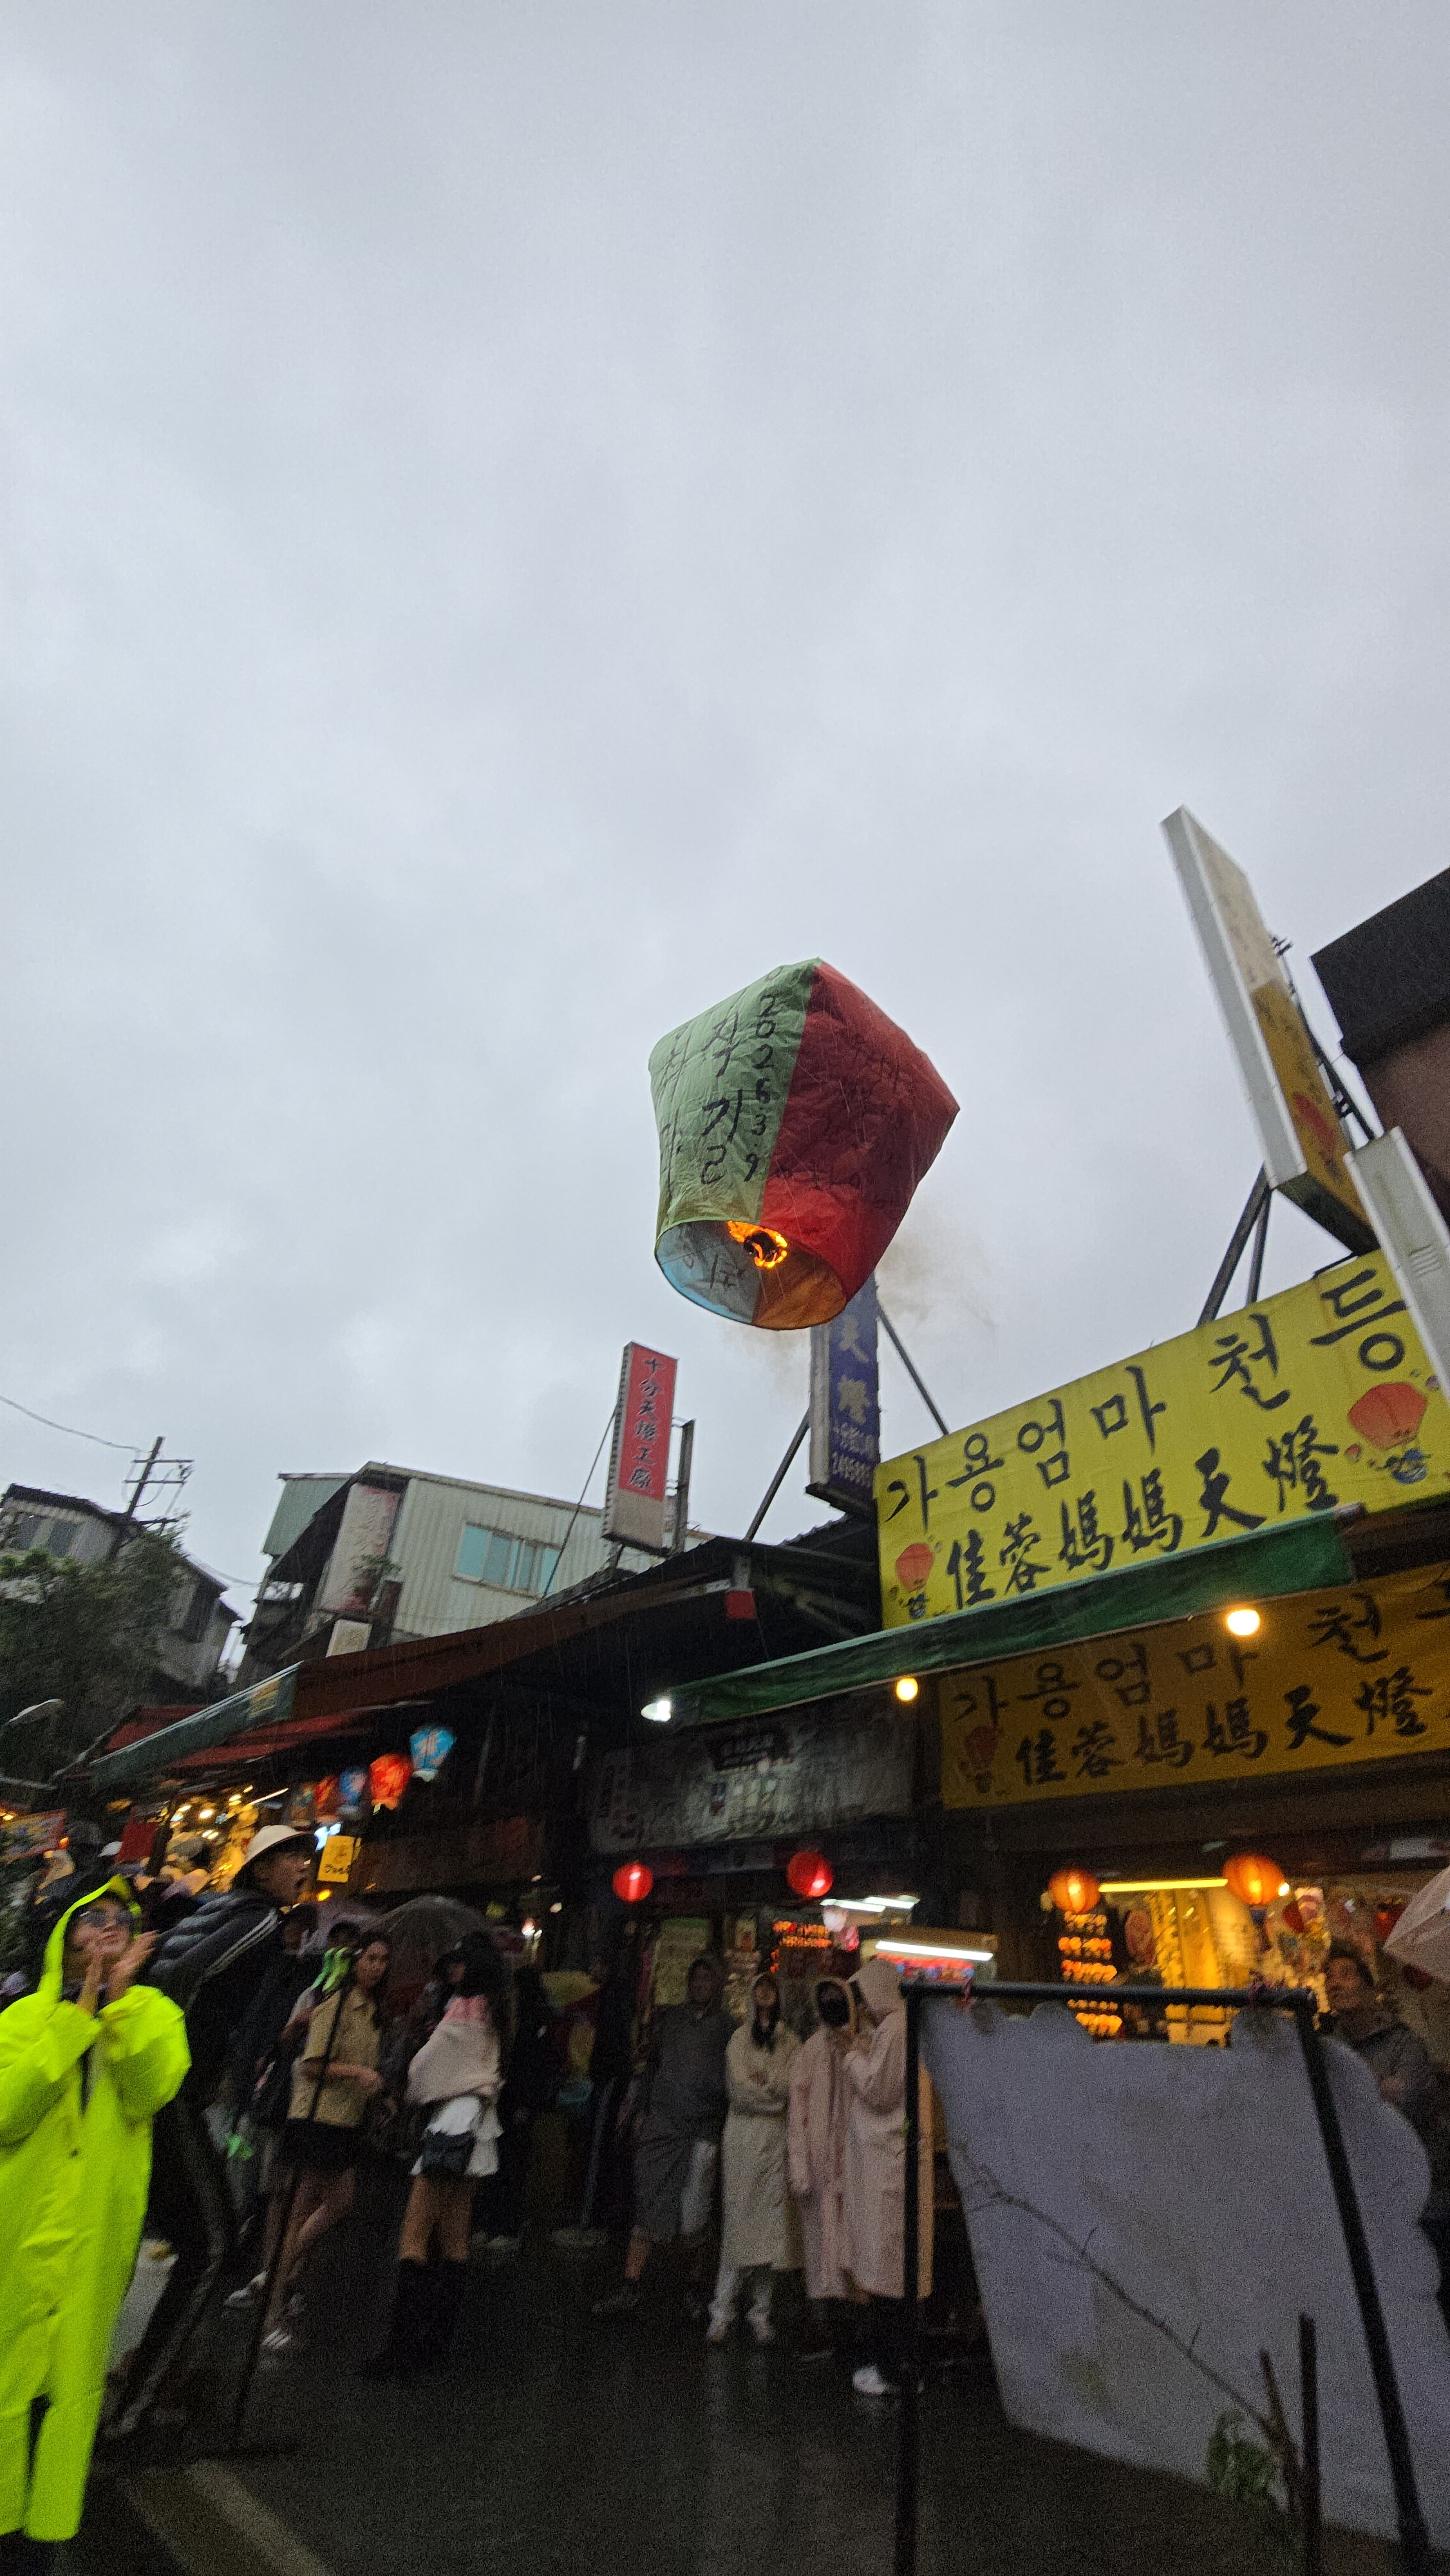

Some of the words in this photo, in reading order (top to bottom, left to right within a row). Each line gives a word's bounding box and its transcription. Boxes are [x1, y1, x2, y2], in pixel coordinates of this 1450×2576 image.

[886, 1364, 1167, 1534] 가용엄마
[1207, 1267, 1408, 1412] 천등
[945, 1414, 1340, 1610] 佳蓉媽媽天燈
[950, 1640, 1259, 1730] 가용엄마
[1014, 1665, 1435, 1786] 佳蓉媽媽天燈
